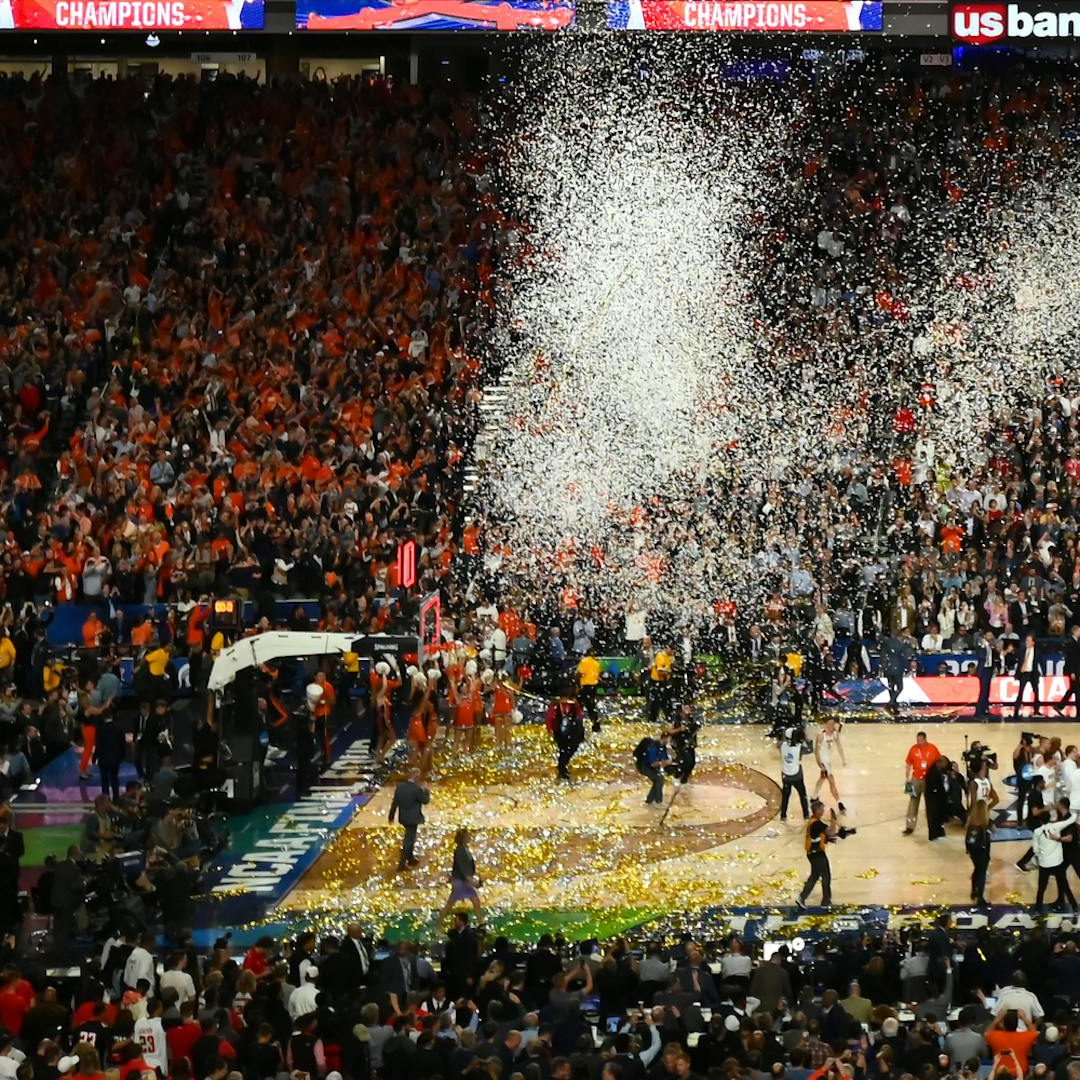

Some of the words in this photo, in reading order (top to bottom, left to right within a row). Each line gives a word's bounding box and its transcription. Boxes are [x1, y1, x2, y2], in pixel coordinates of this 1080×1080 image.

[56, 1, 185, 27] CHAMPIONS
[684, 3, 807, 28] CHAMPIONS
[212, 836, 319, 891] NCAA
